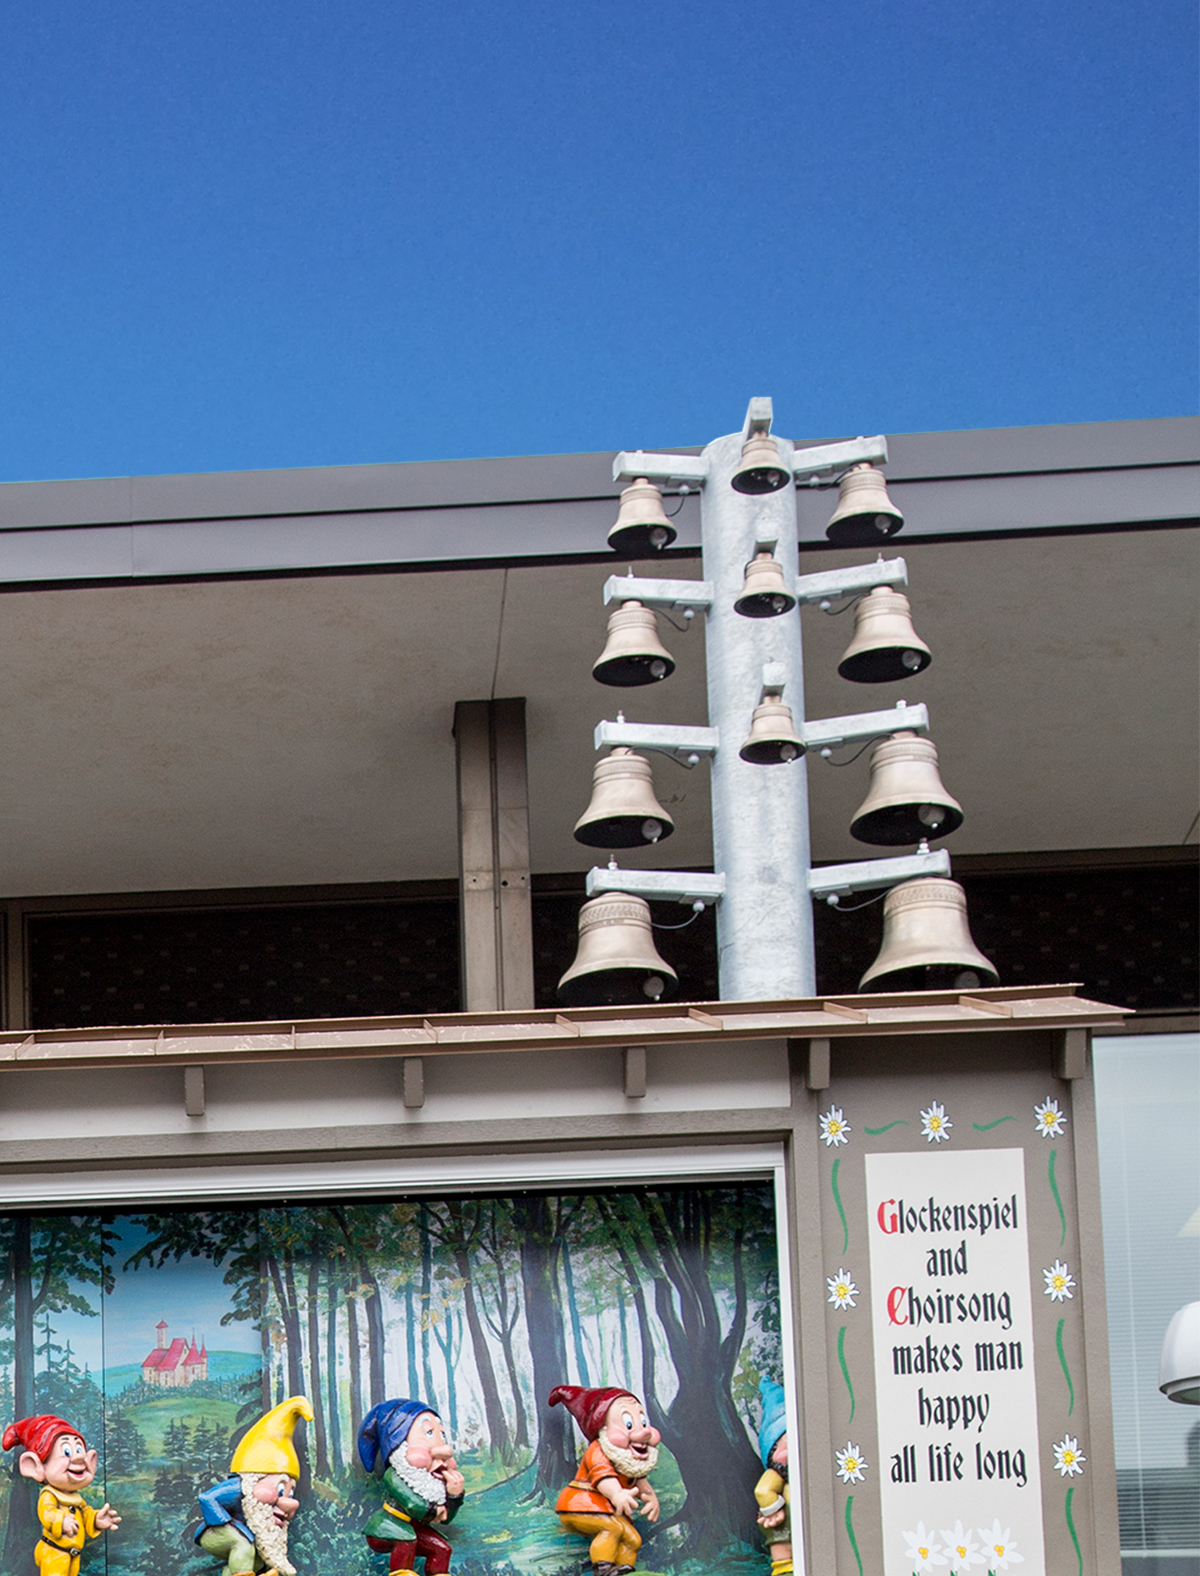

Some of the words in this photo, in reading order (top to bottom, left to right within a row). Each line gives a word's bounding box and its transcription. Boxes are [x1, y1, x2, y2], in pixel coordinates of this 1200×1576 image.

[877, 1195, 1018, 1236] Glockenspiel
[926, 1239, 967, 1277] and
[886, 1285, 1013, 1330] Choirsong
[892, 1335, 963, 1375] makes
[975, 1340, 1024, 1372] man
[918, 1388, 990, 1433] happy
[890, 1445, 917, 1483] all
[927, 1441, 964, 1481] life
[975, 1441, 1028, 1488] long
